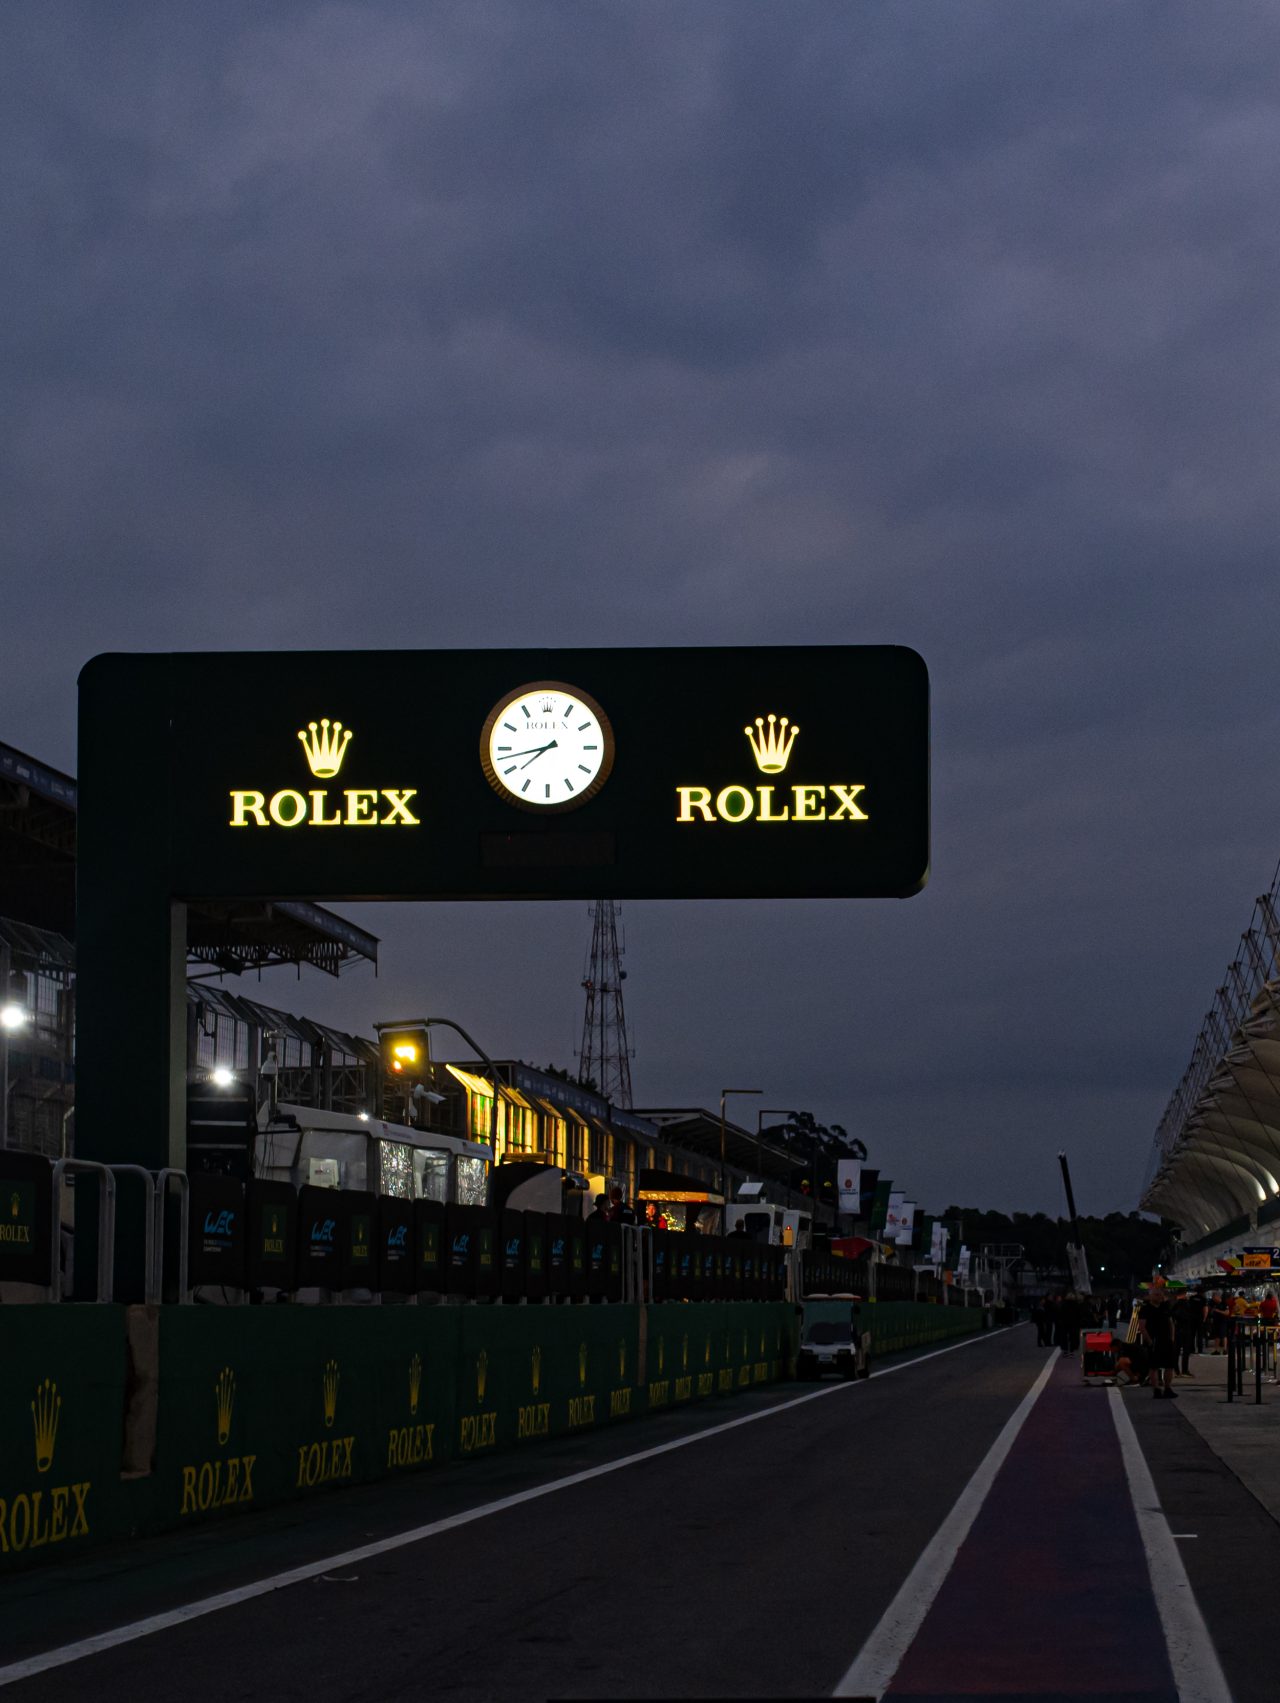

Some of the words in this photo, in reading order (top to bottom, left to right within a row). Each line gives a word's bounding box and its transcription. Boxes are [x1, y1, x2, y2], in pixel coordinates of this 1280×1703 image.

[526, 721, 568, 730] ROLEX
[229, 789, 421, 827] ROLEX
[676, 785, 869, 822] ROLEX
[0, 1223, 30, 1242] ROLEX
[203, 1208, 237, 1236] WEC
[311, 1217, 336, 1242] WEC
[387, 1223, 408, 1246] WEC
[264, 1238, 284, 1253] ROLEX
[1273, 1249, 1280, 1259] 2
[460, 1411, 497, 1451] ROLEX
[517, 1402, 550, 1438] ROLEX
[296, 1435, 356, 1487] ROLEX
[387, 1423, 435, 1470] ROLEX
[180, 1455, 256, 1515] ROLEX
[0, 1481, 92, 1553] ROLEX
